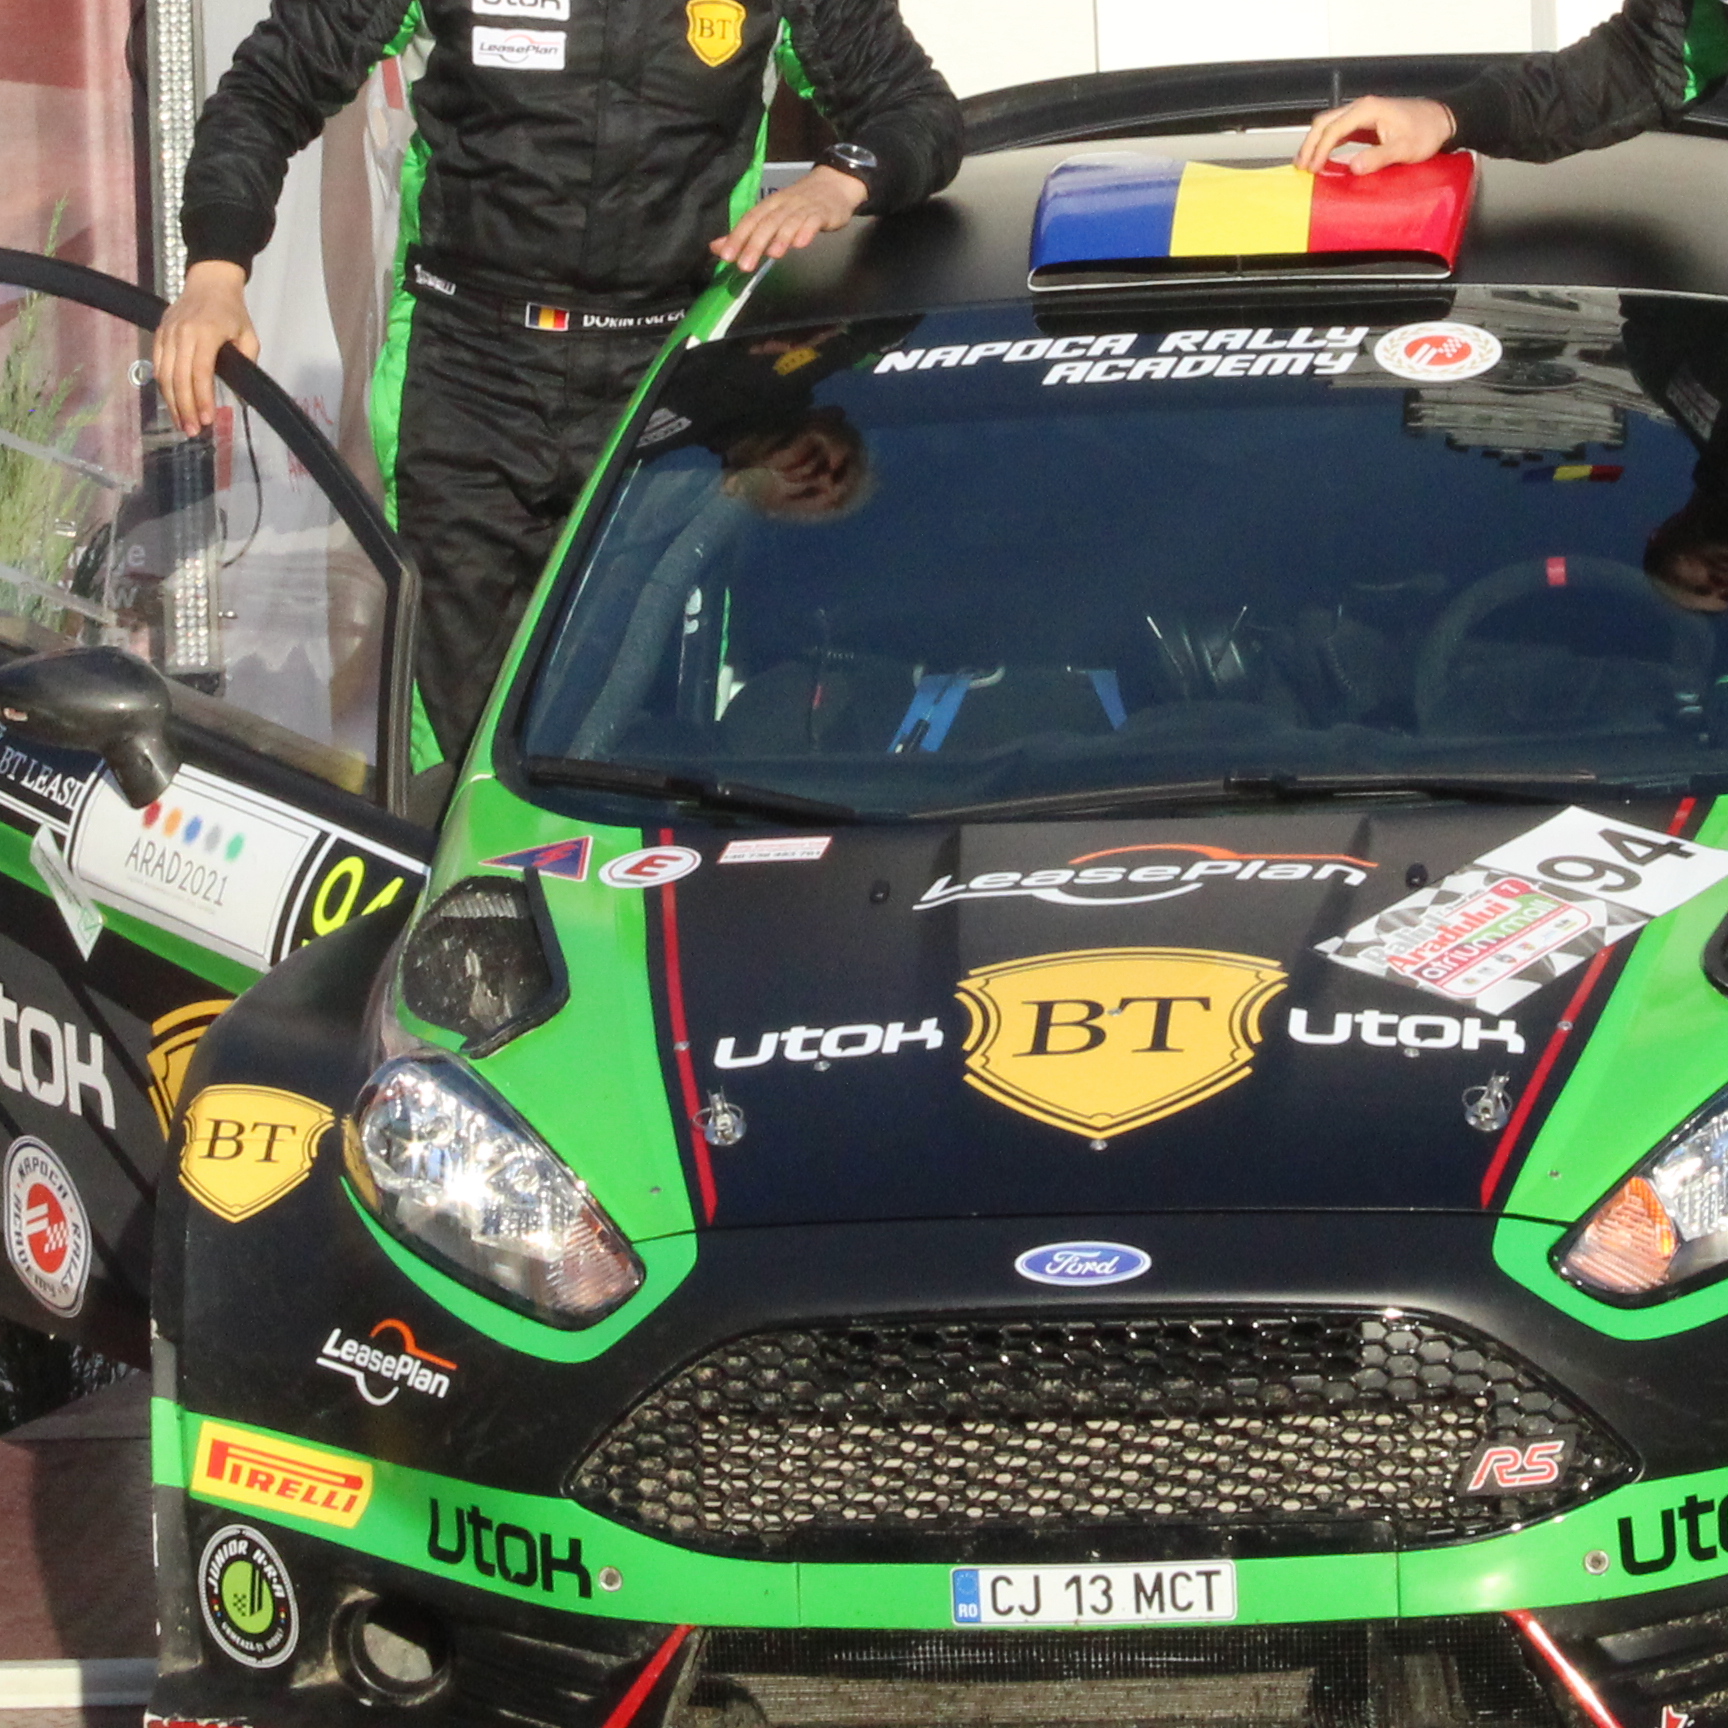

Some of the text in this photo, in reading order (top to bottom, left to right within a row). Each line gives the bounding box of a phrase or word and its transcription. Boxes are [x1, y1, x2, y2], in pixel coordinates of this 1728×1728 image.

[698, 16, 734, 41] BT
[873, 325, 1370, 376] NAPOCA RALLY
[1041, 351, 1360, 388] ACADEMY
[124, 836, 227, 907] ARAD2021
[623, 853, 683, 879] E
[919, 859, 1370, 902] LeasePlan
[1536, 827, 1698, 894] 94
[1386, 898, 1514, 972] Aradului
[1012, 996, 1213, 1059] BT
[198, 1117, 297, 1164] BT
[1043, 1251, 1120, 1277] Ford
[321, 1327, 451, 1400] LeasePlan
[207, 1437, 364, 1514] PIRELLI
[1467, 1440, 1566, 1492] RS
[207, 1538, 249, 1595] JUNIOR
[957, 1602, 979, 1619] RO
[989, 1570, 1223, 1620] CJ 13 MCT
